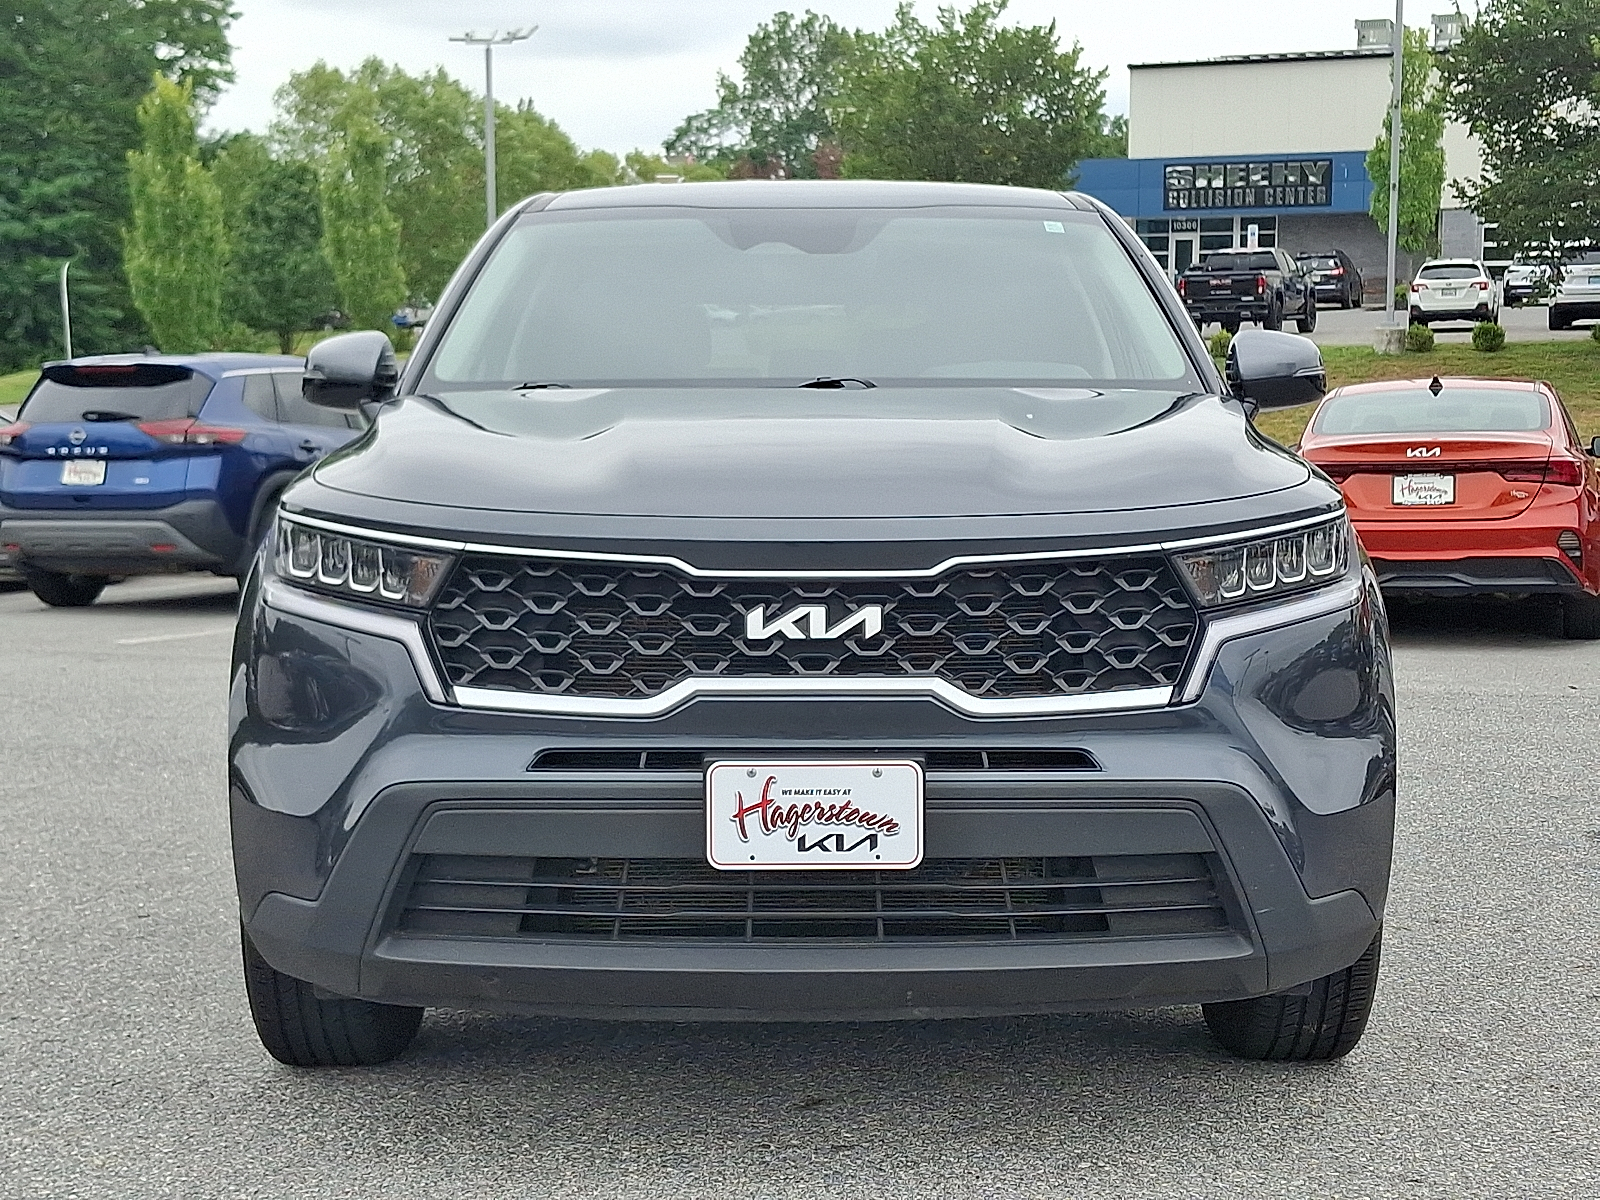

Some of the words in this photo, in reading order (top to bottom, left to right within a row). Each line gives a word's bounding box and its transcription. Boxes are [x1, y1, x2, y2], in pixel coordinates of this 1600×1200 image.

[1166, 161, 1330, 190] SHEEHY
[1168, 188, 1255, 208] COLLISION
[1264, 186, 1326, 206] CENTER
[1407, 447, 1441, 457] KIA
[746, 605, 882, 640] KIA
[731, 775, 900, 839] Hagerstown
[797, 833, 878, 852] KIA
